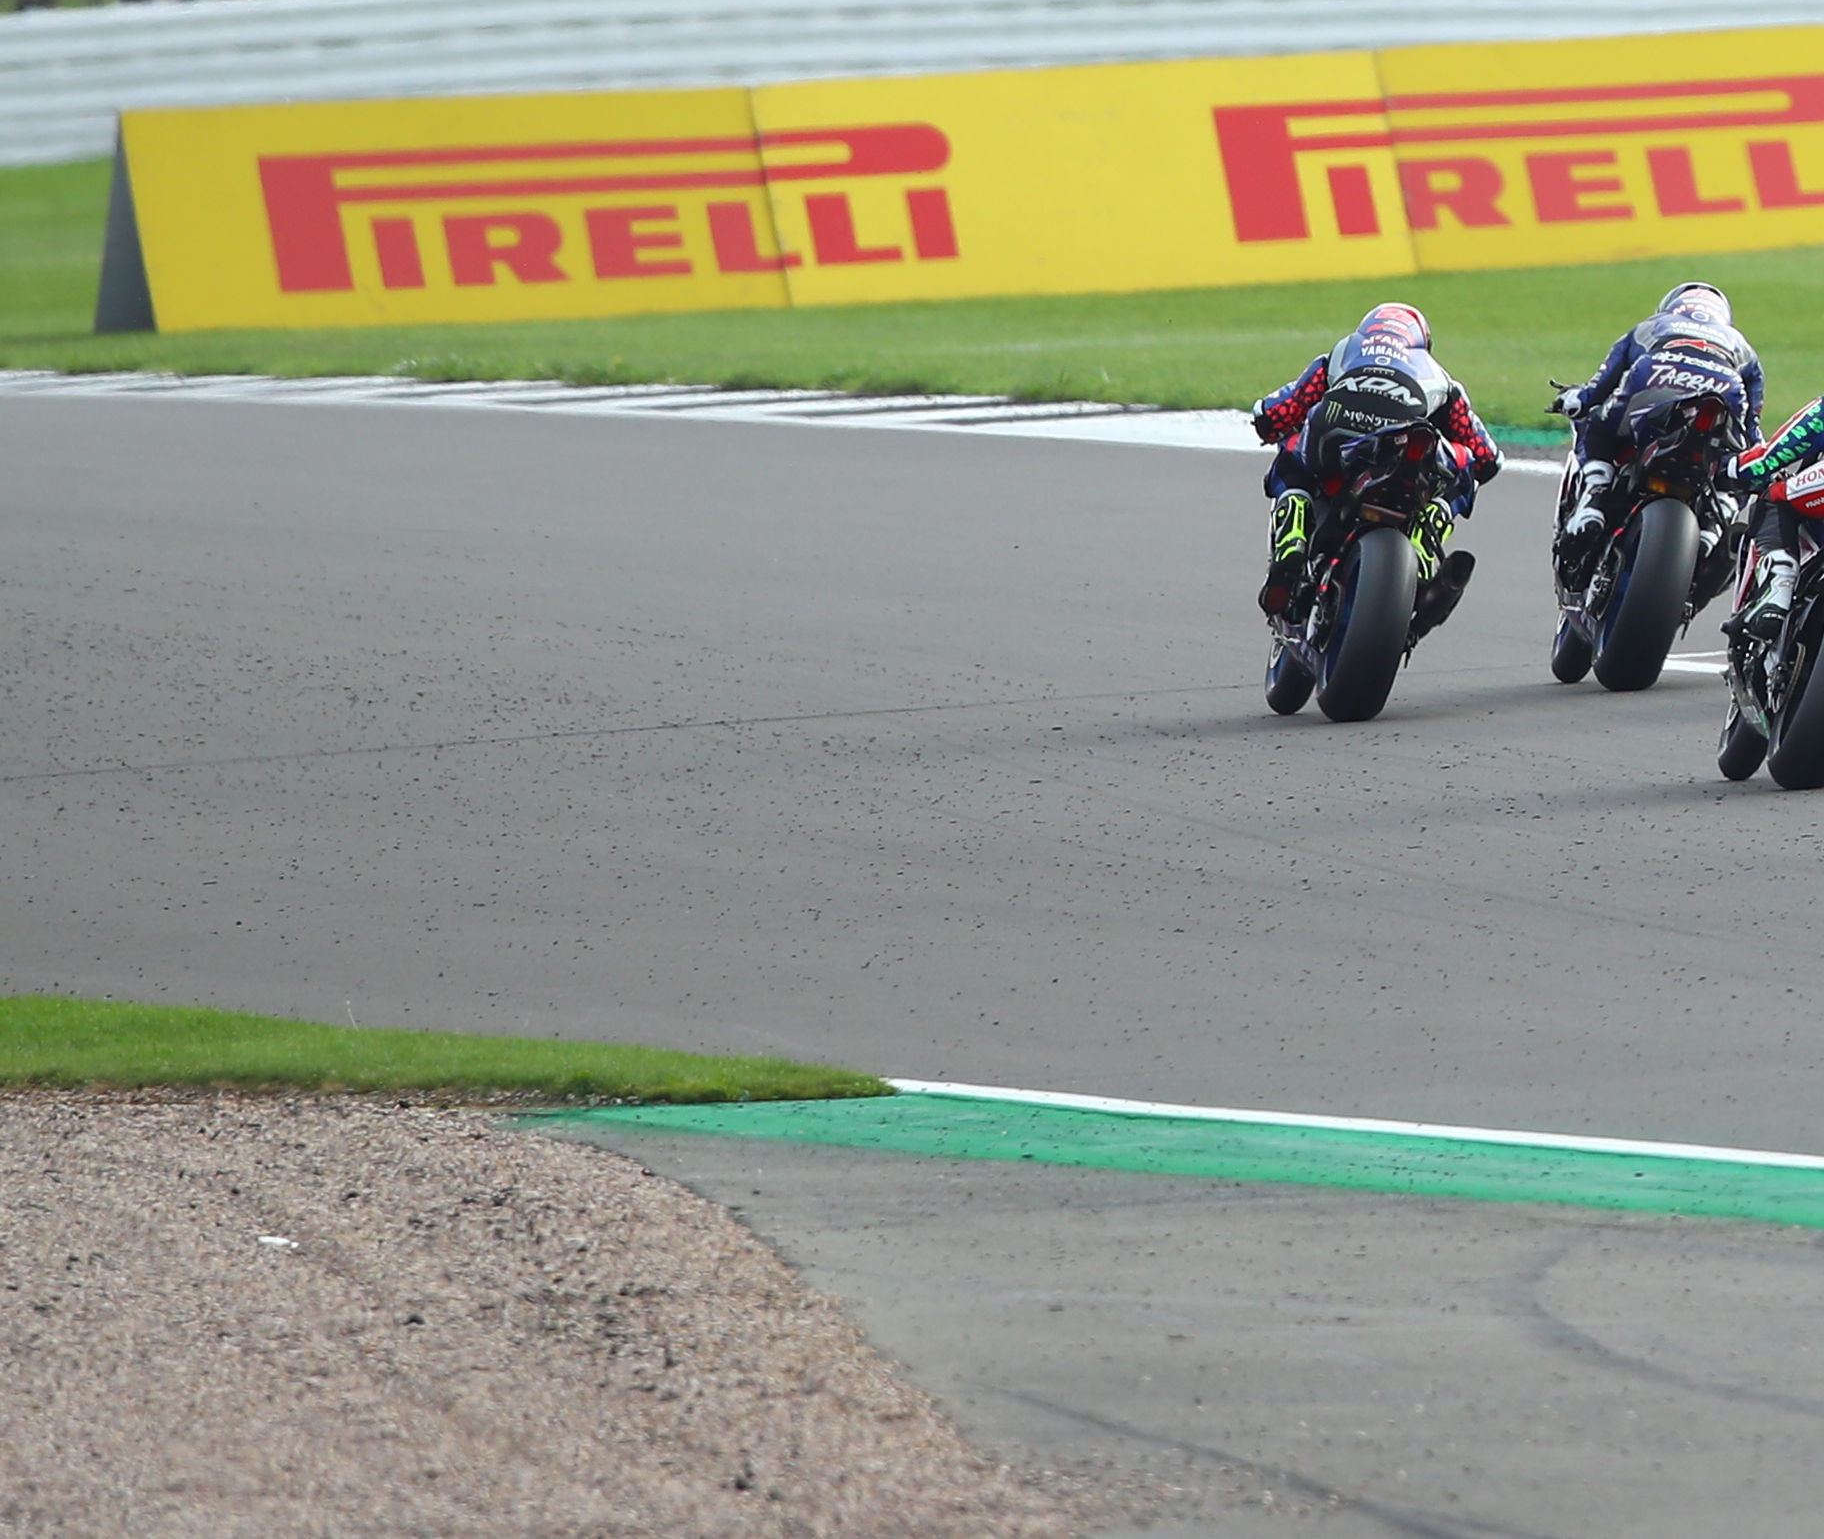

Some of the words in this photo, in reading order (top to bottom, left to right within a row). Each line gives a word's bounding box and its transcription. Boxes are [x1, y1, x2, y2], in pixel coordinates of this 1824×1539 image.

[258, 121, 960, 293] PIRELLI
[1361, 345, 1409, 364] YAMAHA
[1646, 365, 1730, 395] TARRAN
